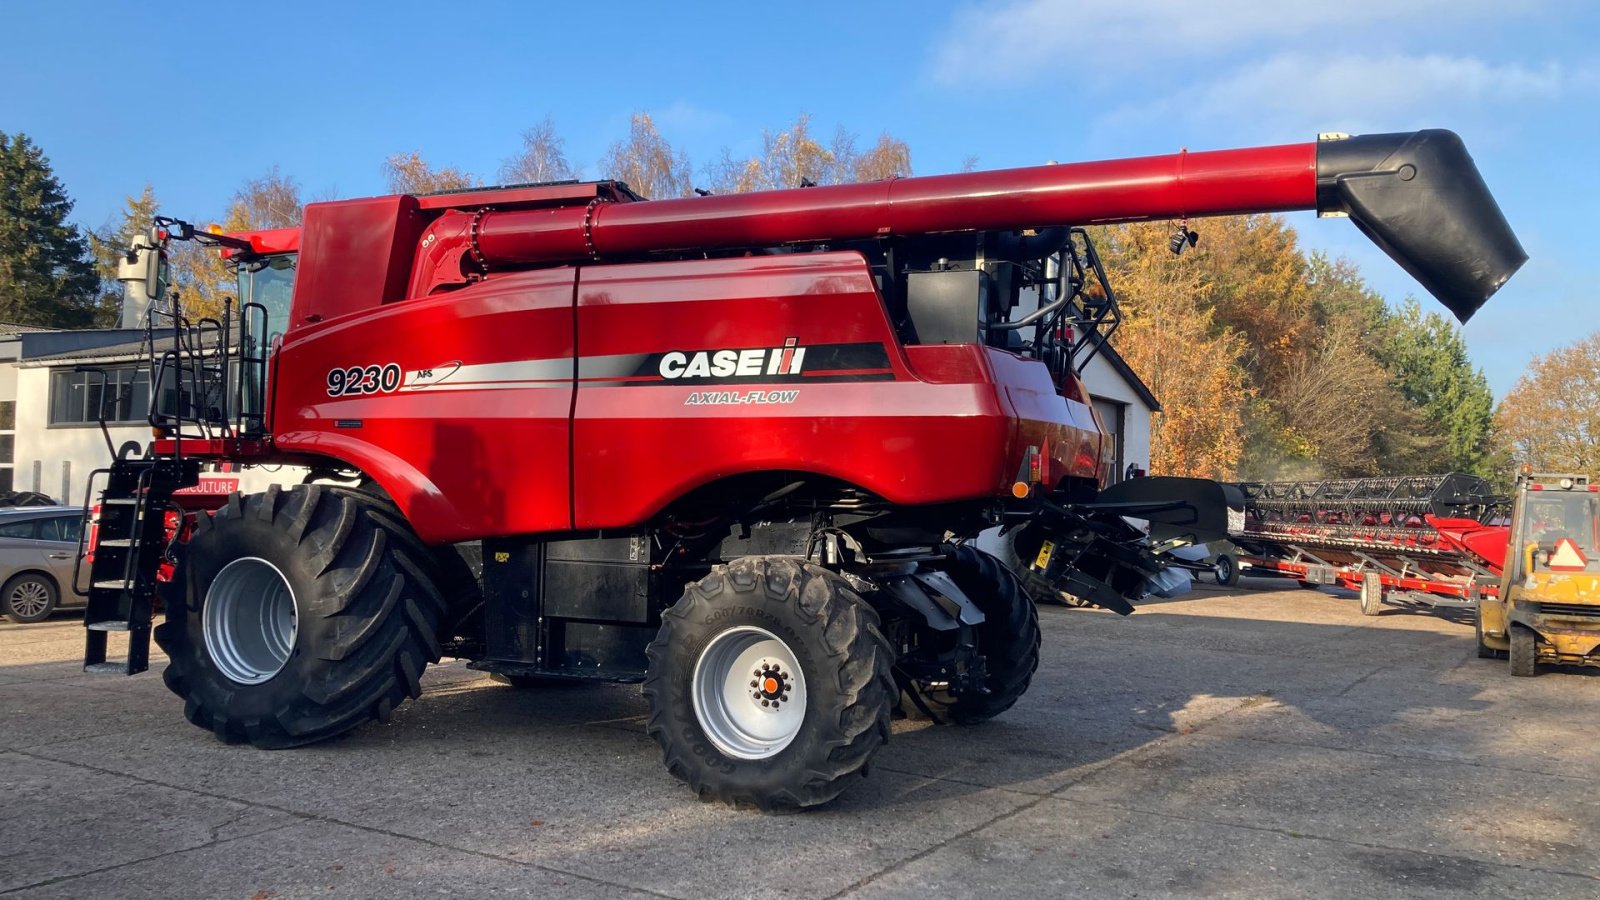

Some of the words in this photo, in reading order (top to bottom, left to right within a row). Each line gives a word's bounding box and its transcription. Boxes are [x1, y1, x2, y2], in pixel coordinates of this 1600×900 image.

[659, 349, 766, 379] CASE
[766, 337, 806, 375] IH
[327, 362, 402, 397] 9230
[416, 369, 433, 379] AFS
[684, 390, 800, 405] AXIAL-FLOW
